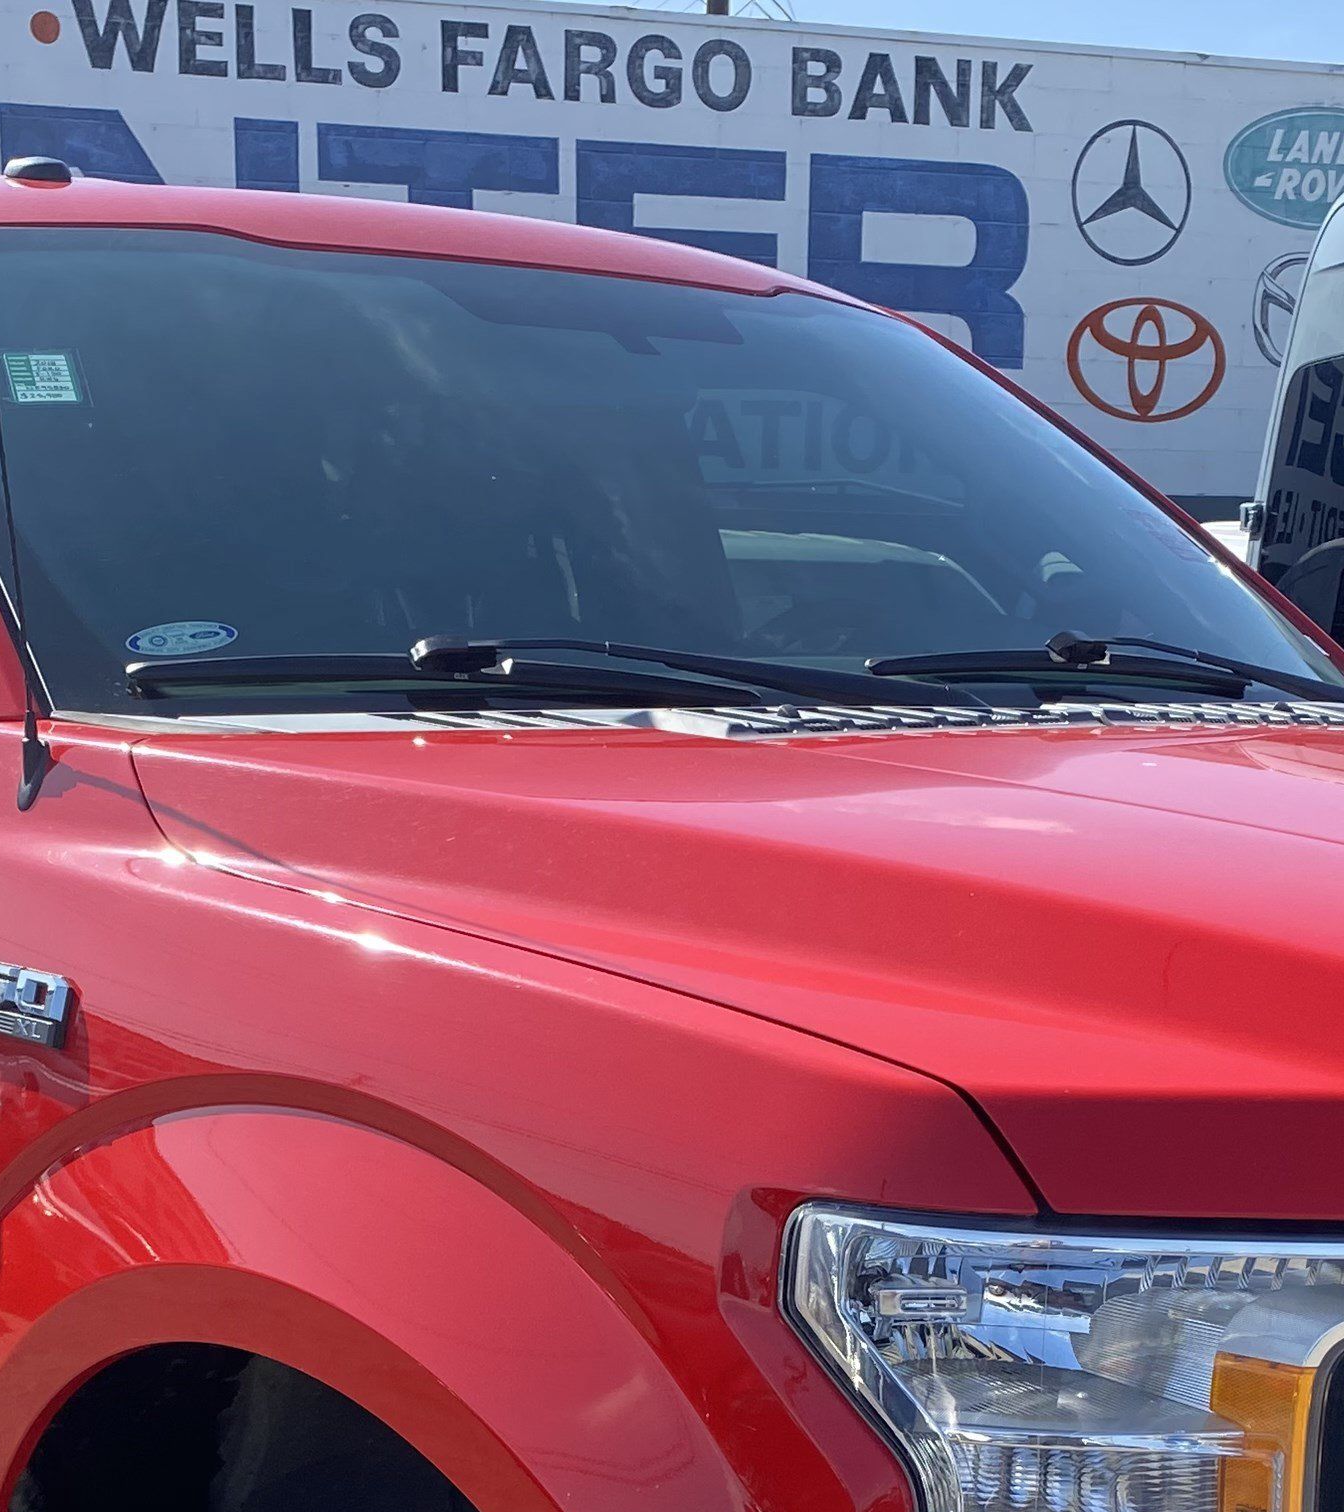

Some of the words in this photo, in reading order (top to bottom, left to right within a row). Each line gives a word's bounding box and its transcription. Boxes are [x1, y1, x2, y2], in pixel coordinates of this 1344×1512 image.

[77, 0, 402, 88] WELLS
[440, 19, 753, 112] FARGO
[791, 46, 1034, 133] BANK
[16, 1017, 41, 1039] XL
